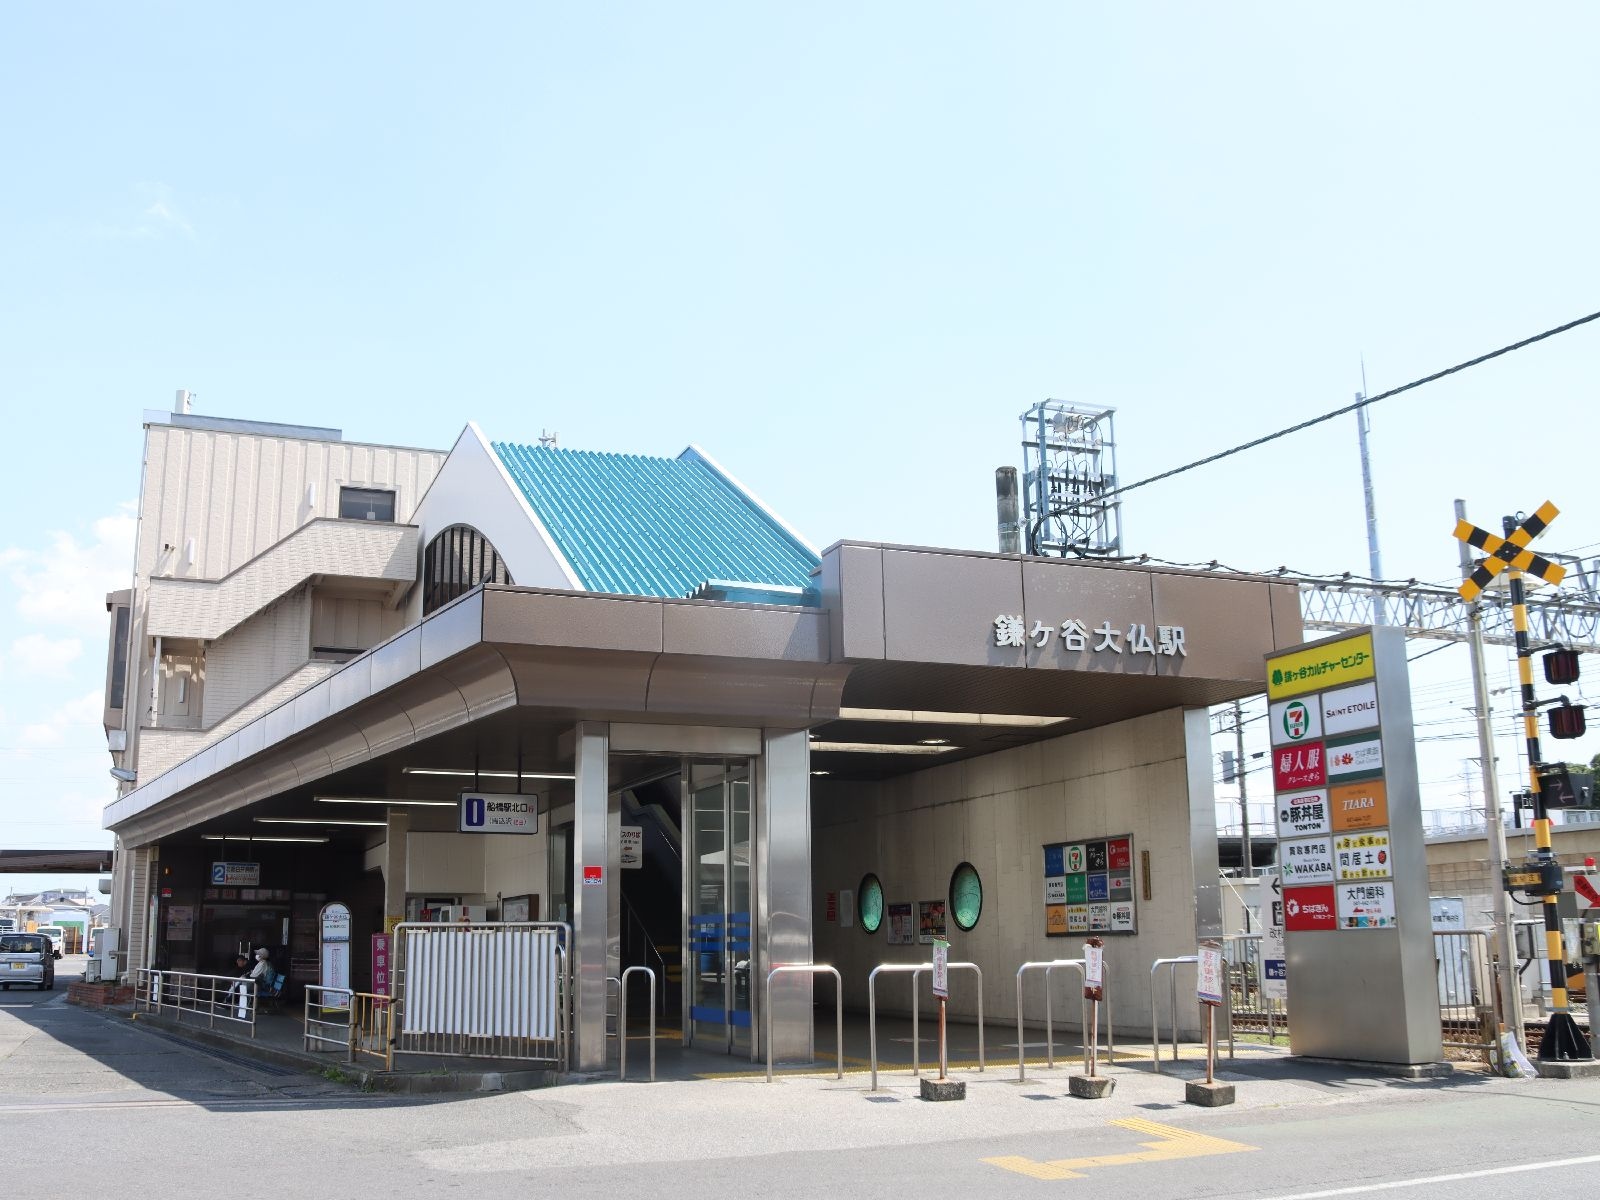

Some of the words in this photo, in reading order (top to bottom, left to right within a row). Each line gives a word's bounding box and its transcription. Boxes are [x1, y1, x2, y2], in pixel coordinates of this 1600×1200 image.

[1280, 748, 1320, 774] 婦人服
[1342, 797, 1375, 811] TIARA
[1290, 803, 1324, 823] 豚丼屋
[1294, 822, 1321, 831] TONTON
[1289, 844, 1326, 856] 買取専門店
[1294, 862, 1333, 874] WAKABA
[1347, 886, 1385, 900] 大門歯科
